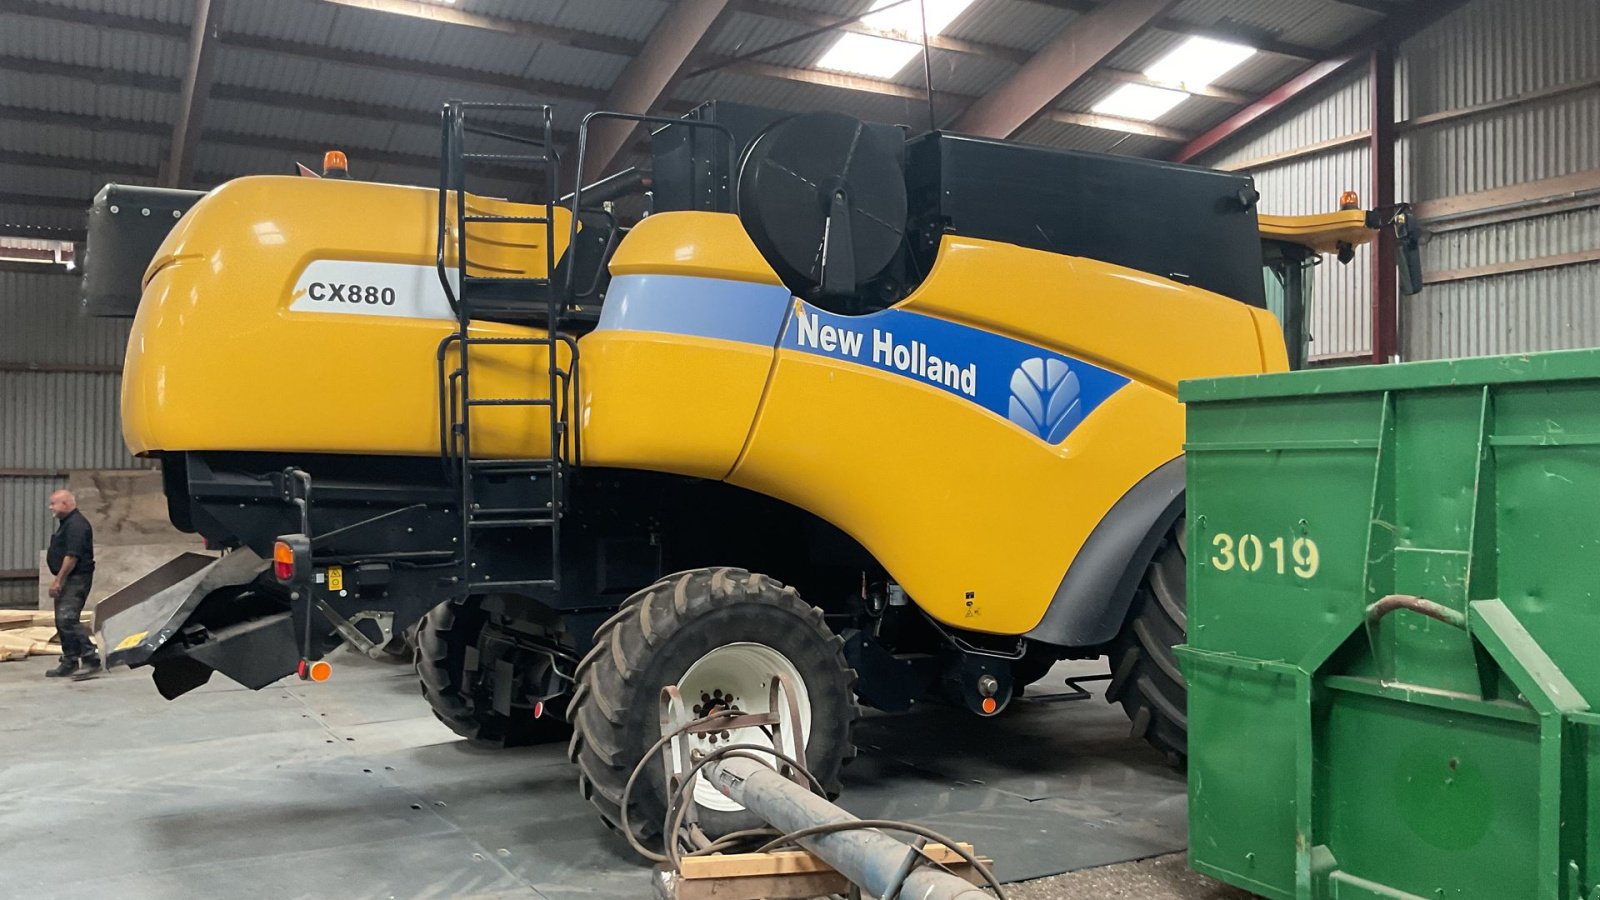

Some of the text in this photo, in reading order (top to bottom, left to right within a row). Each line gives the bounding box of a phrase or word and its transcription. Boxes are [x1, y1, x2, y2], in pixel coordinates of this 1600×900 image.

[308, 282, 396, 306] CX880
[797, 311, 977, 397] New Holland
[1211, 532, 1320, 579] 3019
